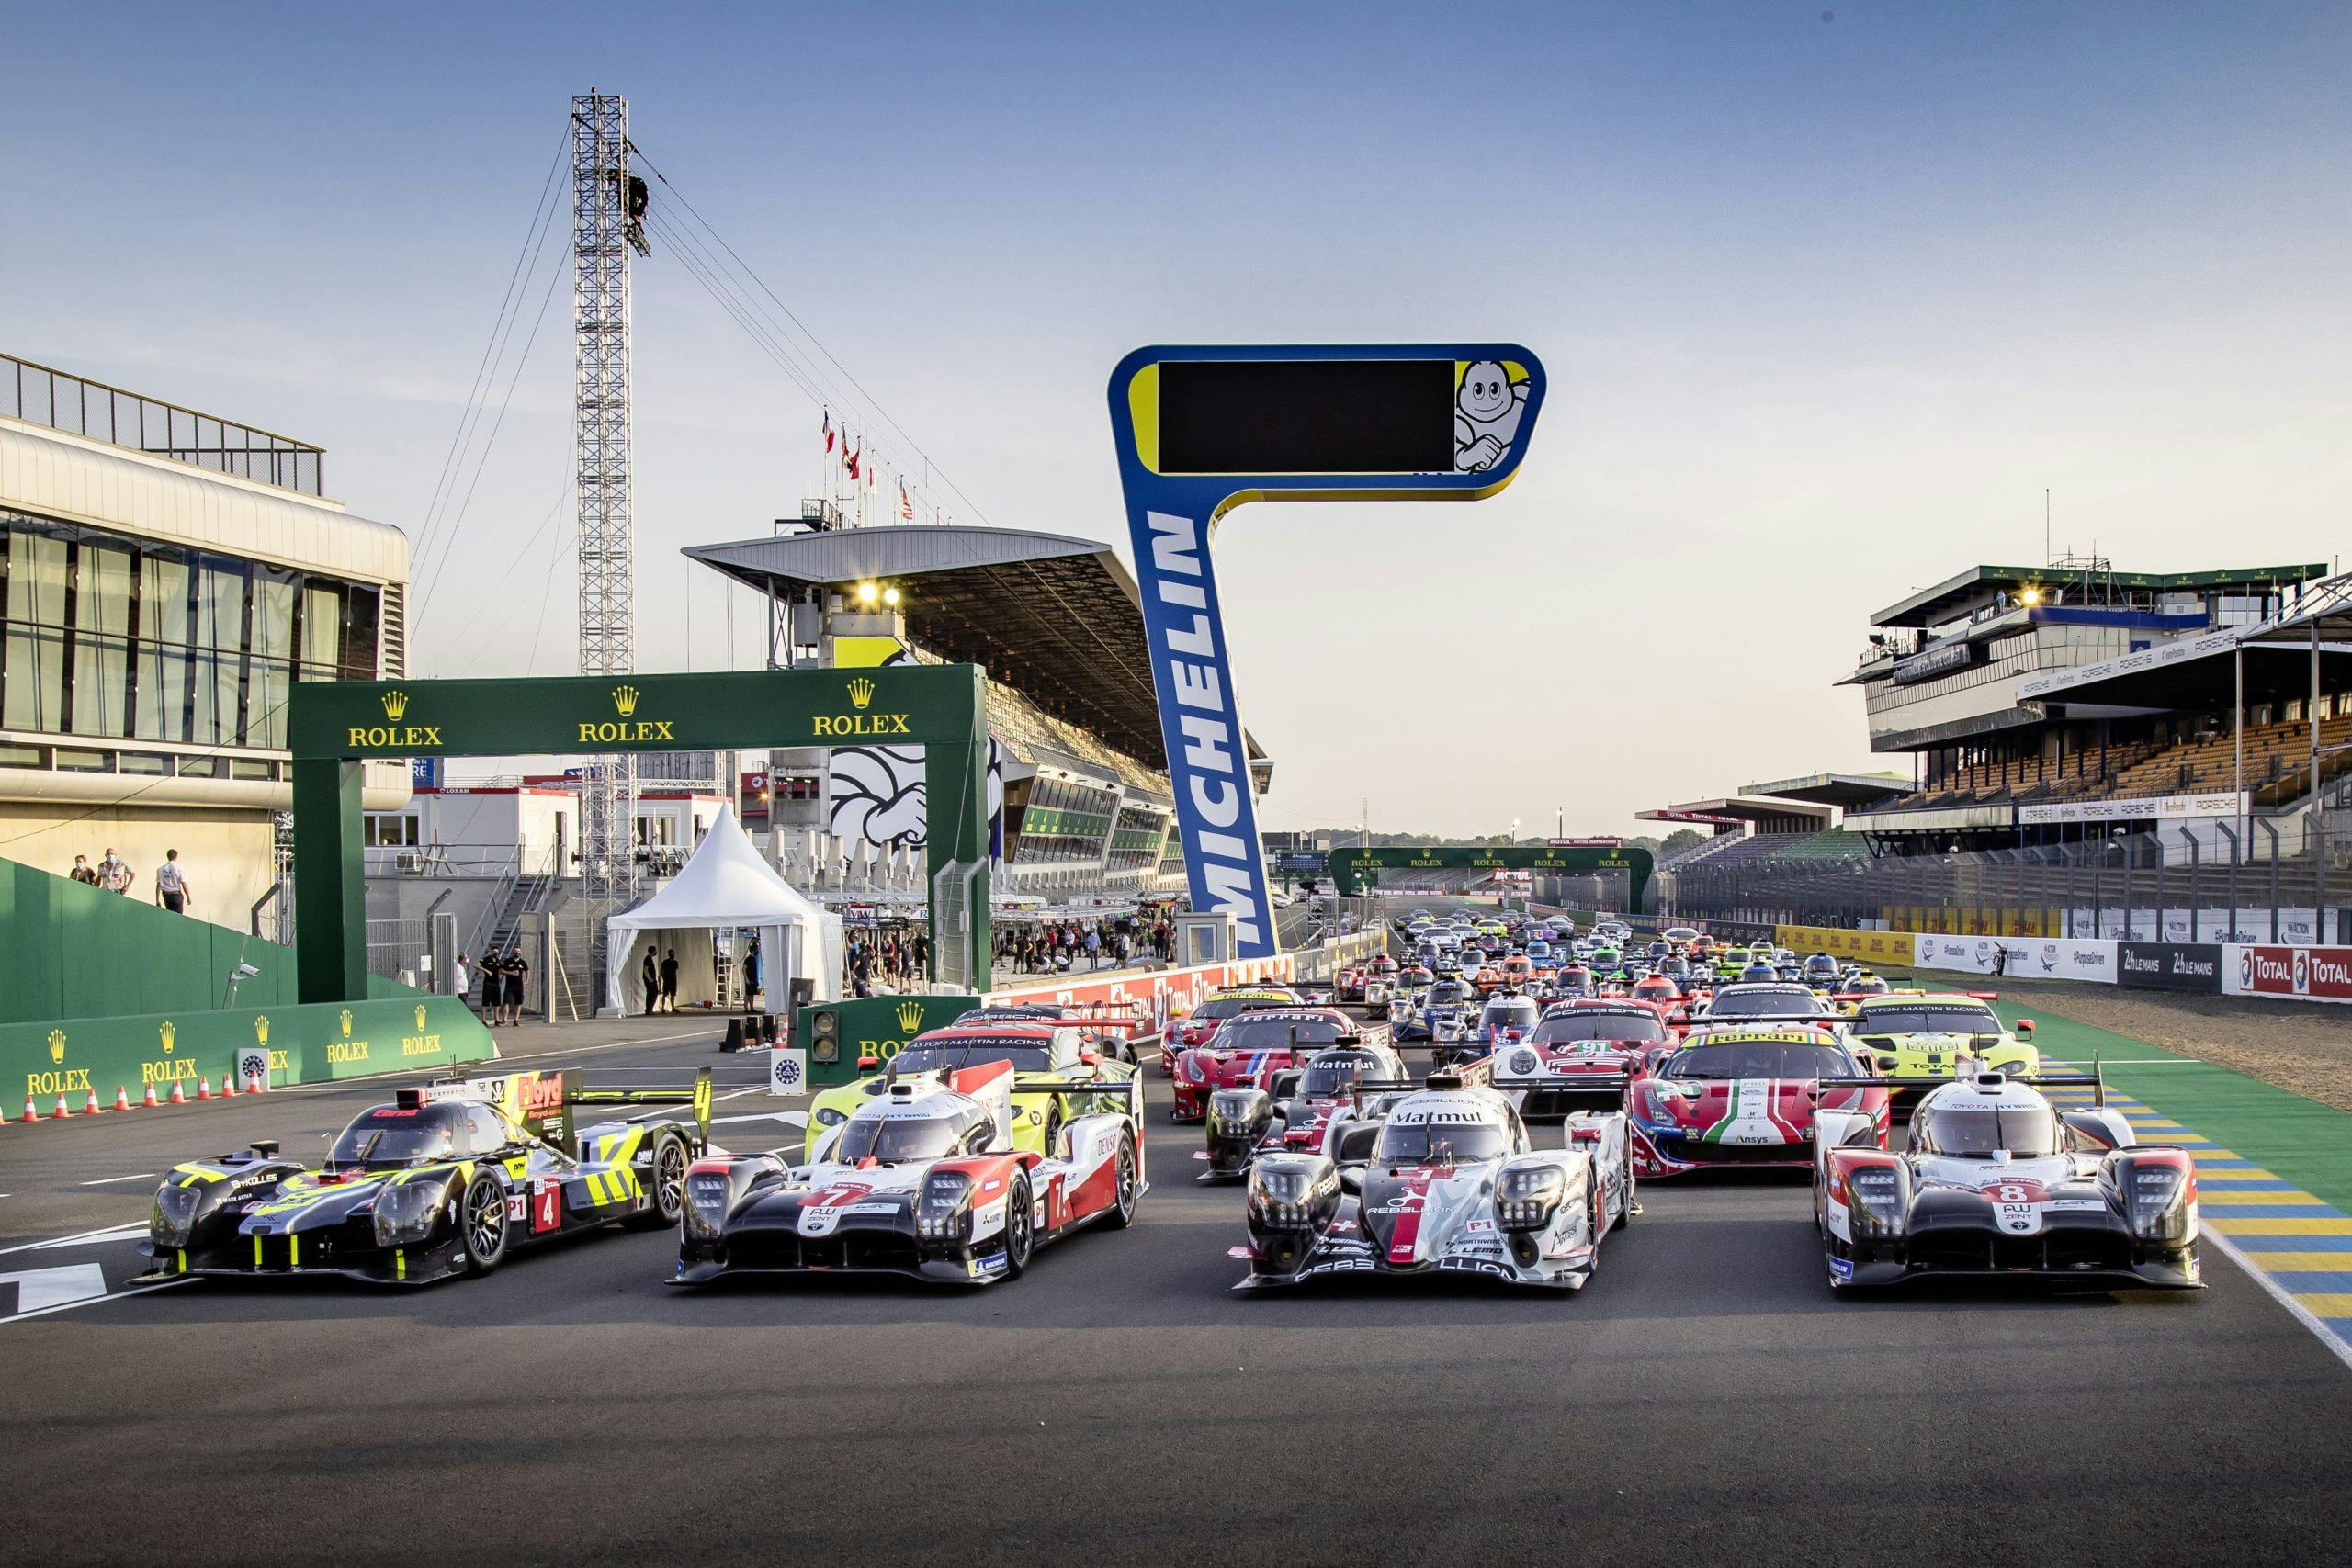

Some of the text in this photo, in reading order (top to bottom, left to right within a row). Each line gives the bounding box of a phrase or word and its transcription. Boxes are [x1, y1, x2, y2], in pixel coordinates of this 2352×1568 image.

[2195, 633, 2235, 653] PORSCHE
[2119, 653, 2152, 671] PORSCHE
[2082, 663, 2112, 680] PORSCHE
[579, 721, 674, 742] ROLEX
[813, 714, 910, 736] ROLEX
[1146, 510, 1261, 944] MICHELIN
[348, 727, 443, 747] ROLEX
[2121, 803, 2154, 815] PORSCHE
[2197, 797, 2236, 811] PORSCHE
[2084, 806, 2113, 817] PORSCHE
[1534, 859, 1566, 867] ROLEX
[1495, 871, 1531, 880] MOTUL
[2143, 959, 2159, 972] MANS
[2193, 962, 2213, 976] MANS
[2256, 955, 2291, 980] TOTAL
[2311, 957, 2352, 985] TOTAL
[1167, 986, 1192, 1011] TOTAL
[1547, 1008, 1653, 1019] PORSCHE
[1864, 1006, 1900, 1014] ASTON
[958, 1012, 1058, 1023] PORSCHE
[1241, 1013, 1324, 1022] Ferrari
[910, 1038, 1047, 1050] ASTON MARTIN RACING
[1713, 1032, 1804, 1043] Ferrari
[327, 1041, 369, 1064] ROLEX
[402, 1035, 441, 1056] ROLEX
[1582, 1043, 1606, 1053] 91
[142, 1058, 198, 1084] ROLEX
[1312, 1060, 1375, 1070] Matmut
[28, 1068, 92, 1096] ROLEX
[518, 1072, 562, 1111] Floyd
[1394, 1111, 1484, 1123] Matmut
[1097, 1133, 1117, 1157] DENSO
[1736, 1134, 1769, 1145] Ansys
[544, 1179, 560, 1189] TOTAL
[2001, 1177, 2041, 1185] TOTAL
[820, 1190, 849, 1206] 7
[1999, 1185, 2029, 1202] 8
[508, 1200, 524, 1217] P1
[543, 1193, 554, 1225] 4
[1367, 1206, 1456, 1214] REBELLION
[1470, 1220, 1492, 1231] P1
